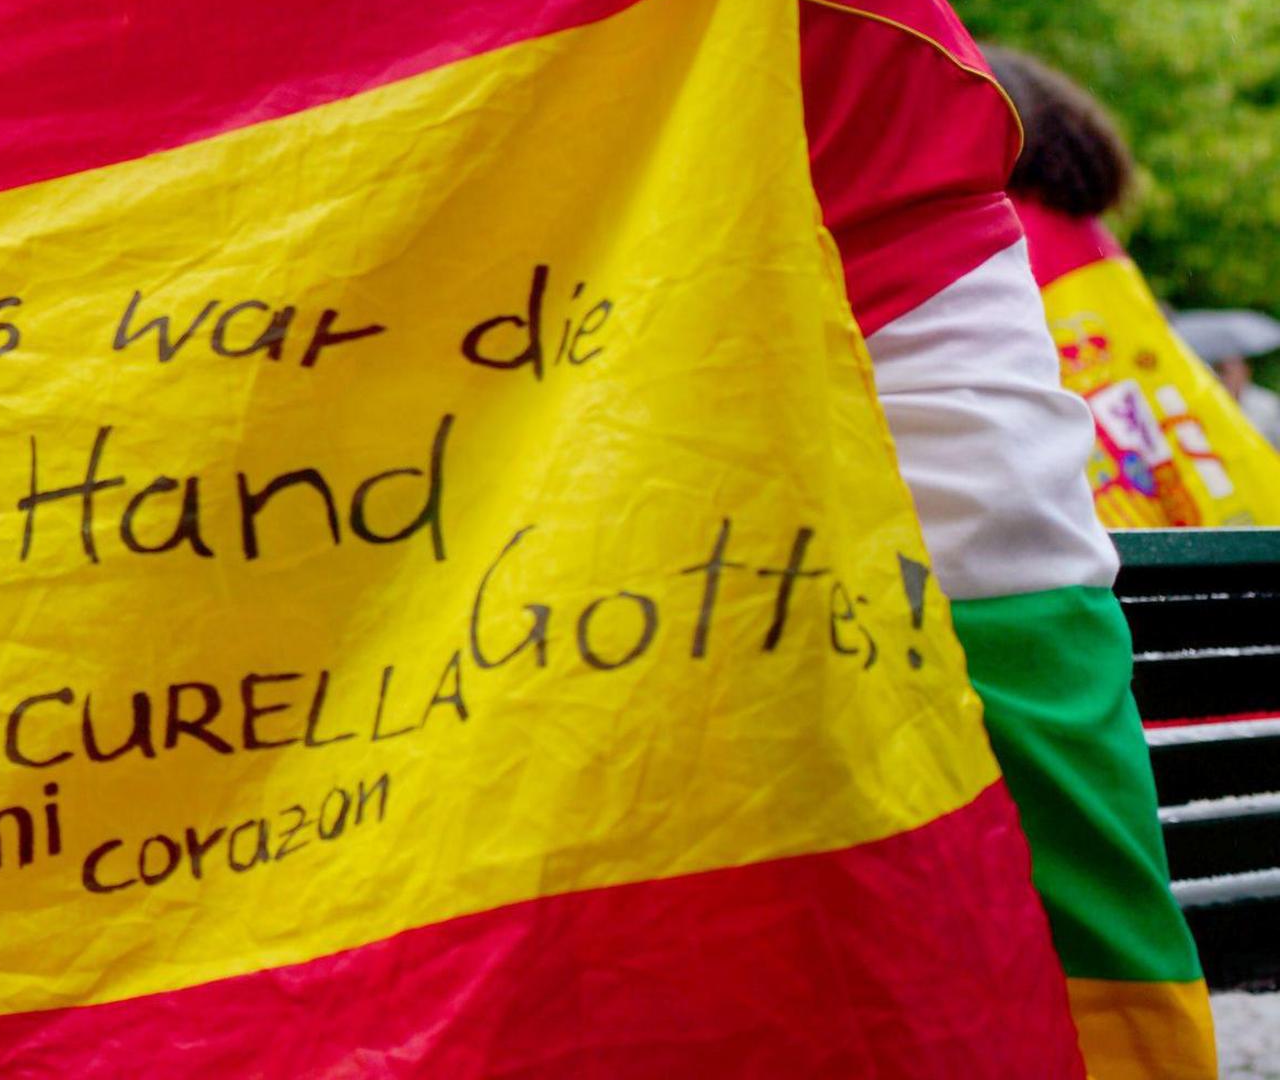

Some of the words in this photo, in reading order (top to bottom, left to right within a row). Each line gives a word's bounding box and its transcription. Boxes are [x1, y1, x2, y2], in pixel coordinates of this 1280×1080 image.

[112, 290, 386, 368] war
[461, 264, 613, 381] die
[17, 414, 454, 561] Hand
[81, 773, 391, 893] corazon
